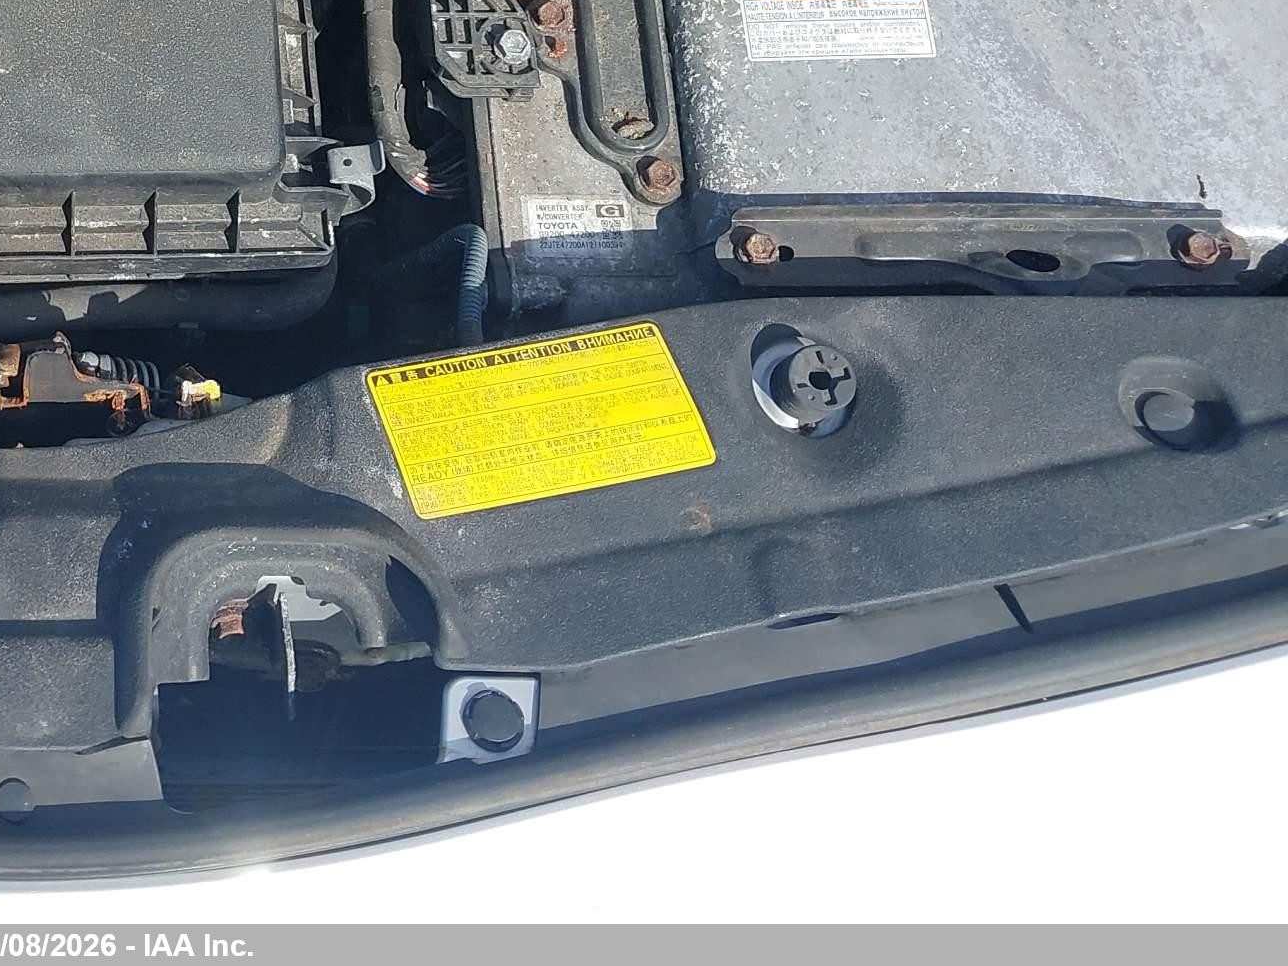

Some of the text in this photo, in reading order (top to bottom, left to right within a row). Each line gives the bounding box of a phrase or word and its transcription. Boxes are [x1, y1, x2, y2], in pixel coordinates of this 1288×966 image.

[760, 0, 784, 10] VOLTAGE
[536, 204, 568, 212] INVERTER
[538, 222, 578, 230] TOYOTA
[424, 357, 487, 376] CAUTION
[492, 342, 572, 364] ATTENTION
[576, 327, 653, 349] ВНИМАНИЕ
[411, 469, 450, 483] READY
